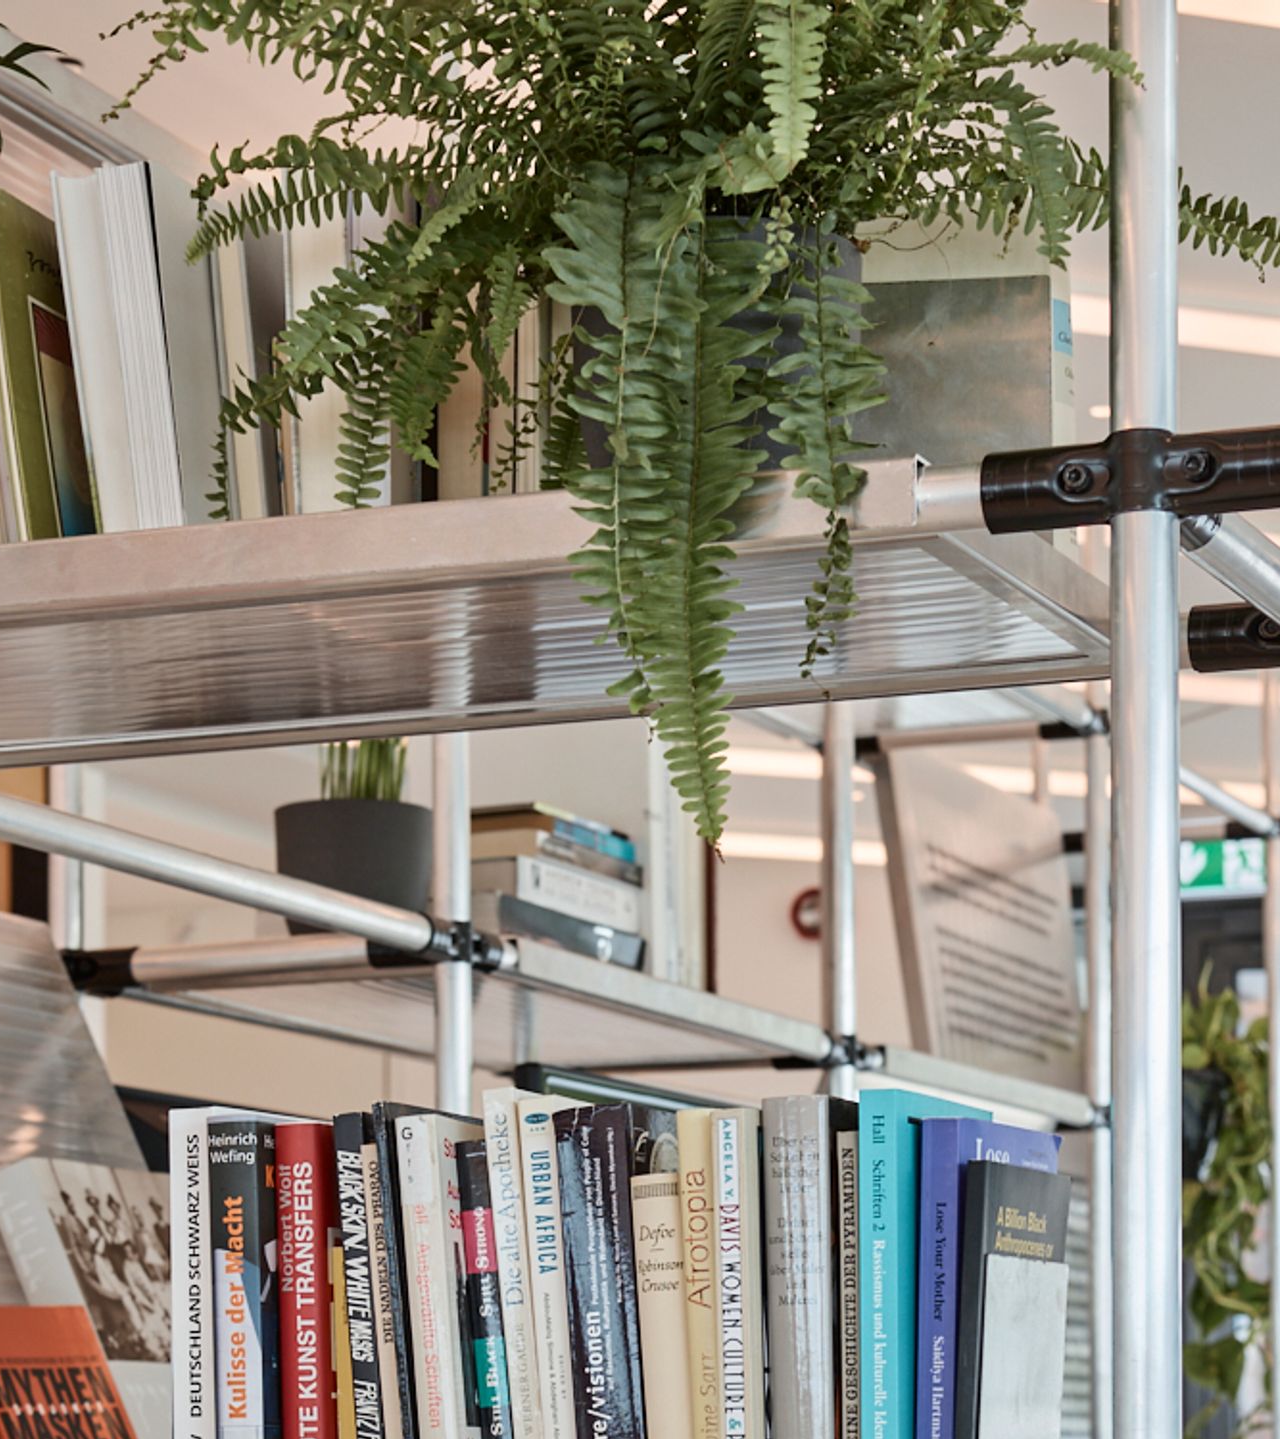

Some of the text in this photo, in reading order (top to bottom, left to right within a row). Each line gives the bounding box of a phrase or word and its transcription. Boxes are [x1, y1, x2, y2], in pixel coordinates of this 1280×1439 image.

[187, 1134, 200, 1187] WEISS
[208, 1133, 258, 1148] Heinrich
[210, 1150, 255, 1165] Wefing
[721, 1119, 734, 1183] ANGELA
[976, 1138, 1010, 1164] Lose
[337, 1150, 363, 1201] BLACK
[530, 1150, 553, 1206] URBAN
[842, 1148, 856, 1250] PYRAMIDEN
[872, 1115, 887, 1232] Hall Schriften 2
[187, 1192, 201, 1281] SCHWARZ
[278, 1164, 294, 1293] Norbert Wolf
[293, 1162, 315, 1310] TRANSFERS
[490, 1112, 525, 1308] Die alte Apotheke
[639, 1223, 676, 1247] Defoe
[682, 1169, 714, 1309] Afrotopia
[720, 1204, 741, 1253] DAVIS
[1028, 1211, 1047, 1234] Black
[368, 1161, 394, 1344] DIE NADELN DES PHARAO
[534, 1214, 558, 1275] AFRICA
[844, 1253, 857, 1288] DER
[872, 1239, 887, 1309] Rassismus
[933, 1202, 947, 1321] Lose Your Mother
[223, 1196, 247, 1419] Kulisse der Macht
[345, 1256, 372, 1317] WHITE
[641, 1279, 680, 1294] Crusoe
[188, 1284, 202, 1417] DEUTSCHLAND
[349, 1318, 375, 1363] MASKS
[845, 1293, 858, 1400] GESCHICHTE
[873, 1313, 887, 1339] und
[296, 1317, 318, 1399] KUNST
[700, 1352, 719, 1398] Sarr
[723, 1338, 745, 1414] CULTURE
[873, 1343, 887, 1407] kulturelle
[930, 1336, 945, 1384] Saidiya
[354, 1380, 381, 1430] FRANTZ
[424, 1354, 443, 1429] Schriften
